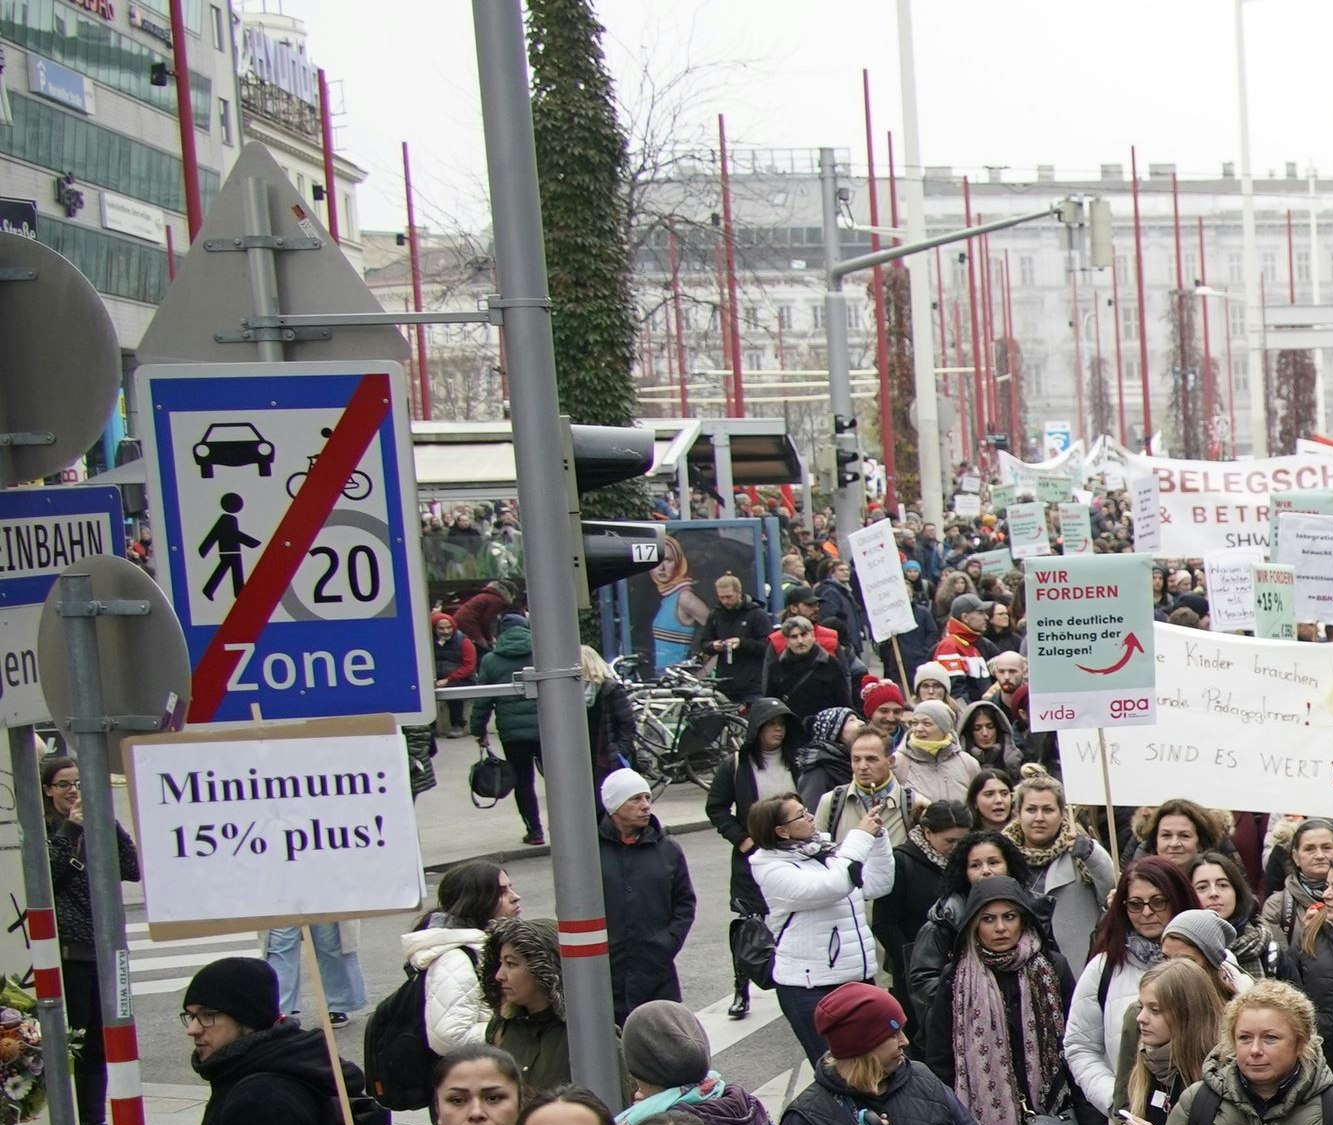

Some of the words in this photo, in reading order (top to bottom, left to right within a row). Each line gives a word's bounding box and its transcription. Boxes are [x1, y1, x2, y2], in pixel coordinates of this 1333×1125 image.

[1159, 508, 1172, 524] &
[0, 520, 103, 572] INBAHN
[635, 545, 656, 560] 17
[308, 545, 380, 603] 20
[1036, 571, 1068, 584] WIR
[1036, 585, 1118, 601] FORDERN
[1037, 617, 1063, 627] eine
[1067, 614, 1124, 626] deutliche
[1037, 630, 1098, 642] Erhöhung
[1101, 629, 1121, 639] der
[1038, 645, 1093, 658] Zulagen!
[223, 642, 376, 692] Zone
[1185, 641, 1234, 672] Kinder
[1255, 654, 1319, 688] brauchen
[1039, 705, 1075, 721] vida
[1110, 698, 1149, 719] gpa
[1145, 743, 1200, 763] SIND
[1215, 748, 1238, 769] ES
[157, 768, 387, 805] Minimum:
[169, 821, 267, 858] 15%
[283, 815, 385, 861] plus!
